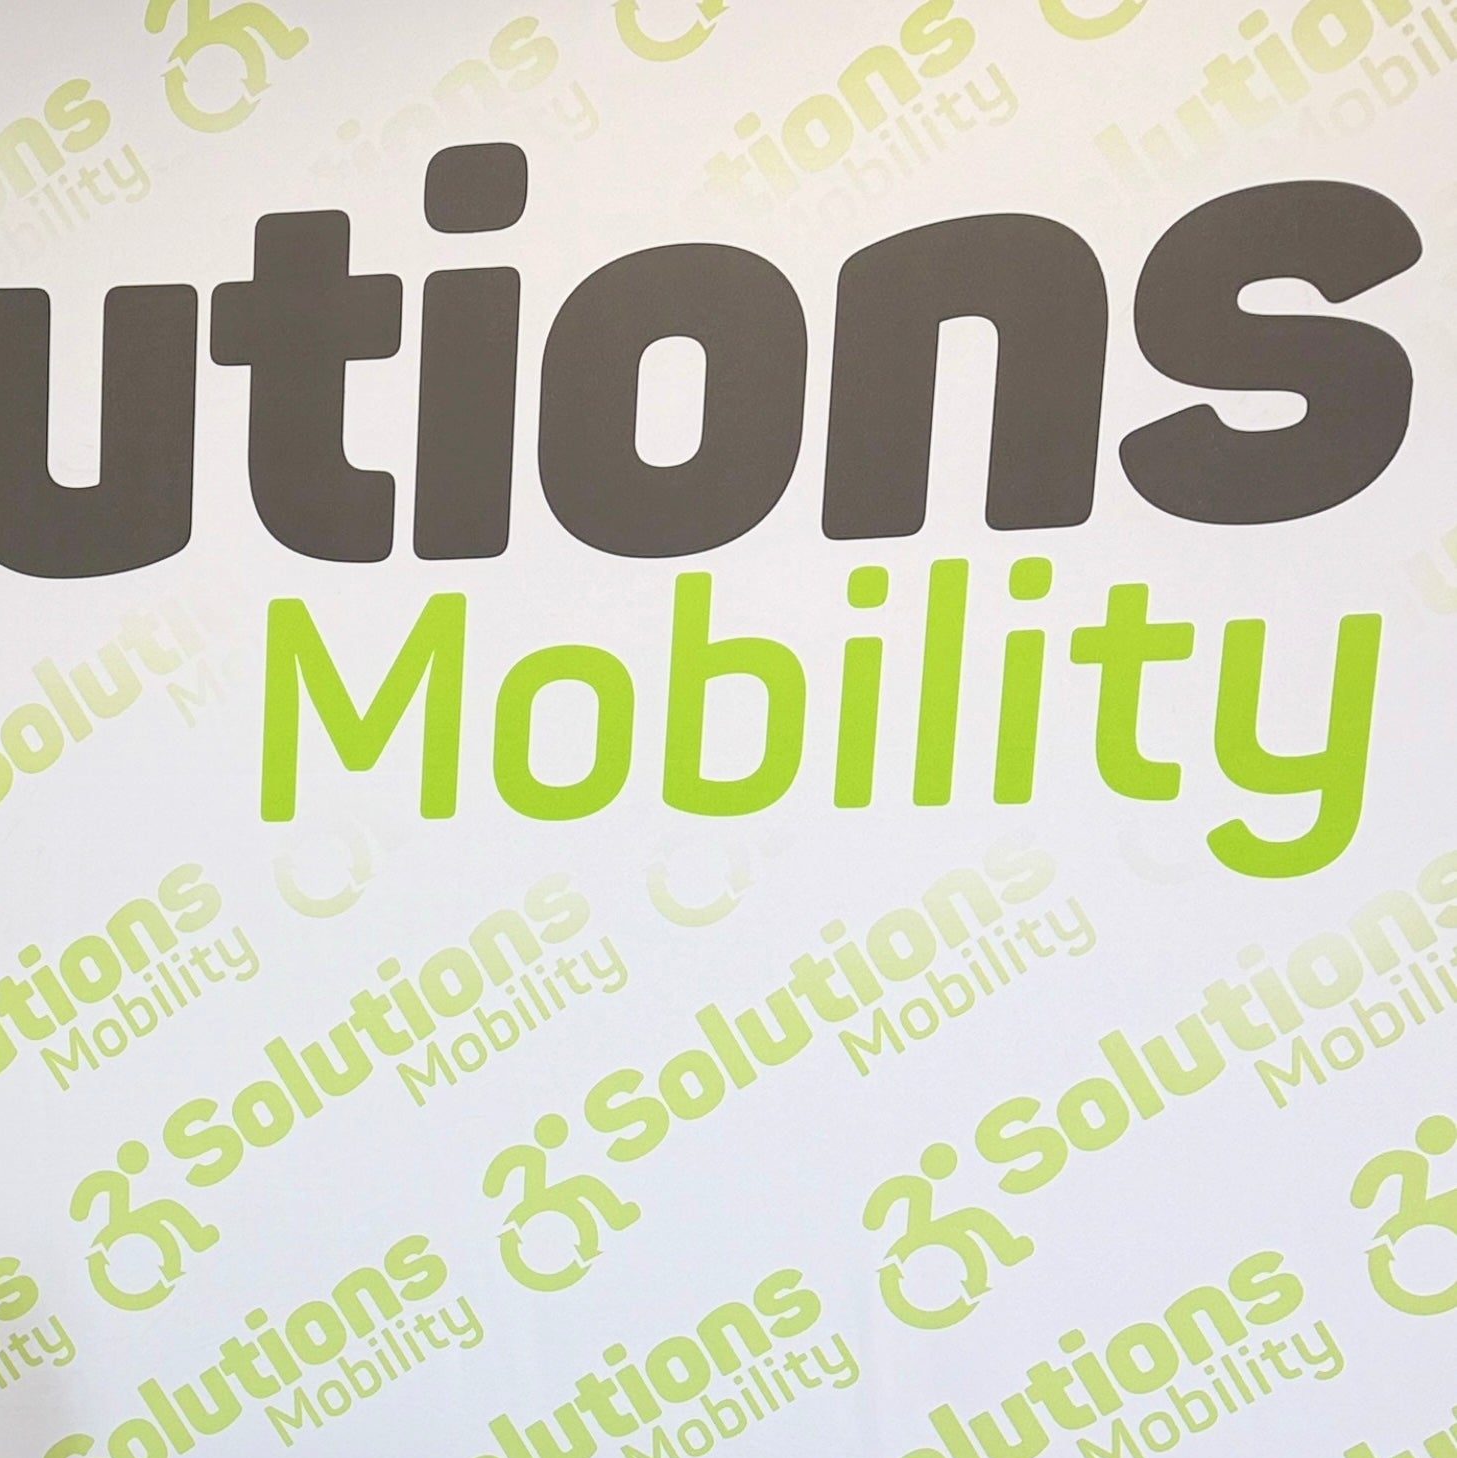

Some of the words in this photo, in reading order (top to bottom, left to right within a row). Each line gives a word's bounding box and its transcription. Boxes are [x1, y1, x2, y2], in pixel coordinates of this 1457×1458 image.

[260, 557, 1382, 879] Mobility
[40, 926, 259, 1091] Mobility
[163, 872, 590, 1187] Solutions
[396, 936, 628, 1107] Mobility
[584, 835, 1056, 1162] Solutions
[838, 896, 1097, 1077] Mobility
[264, 1296, 484, 1446] Mobility
